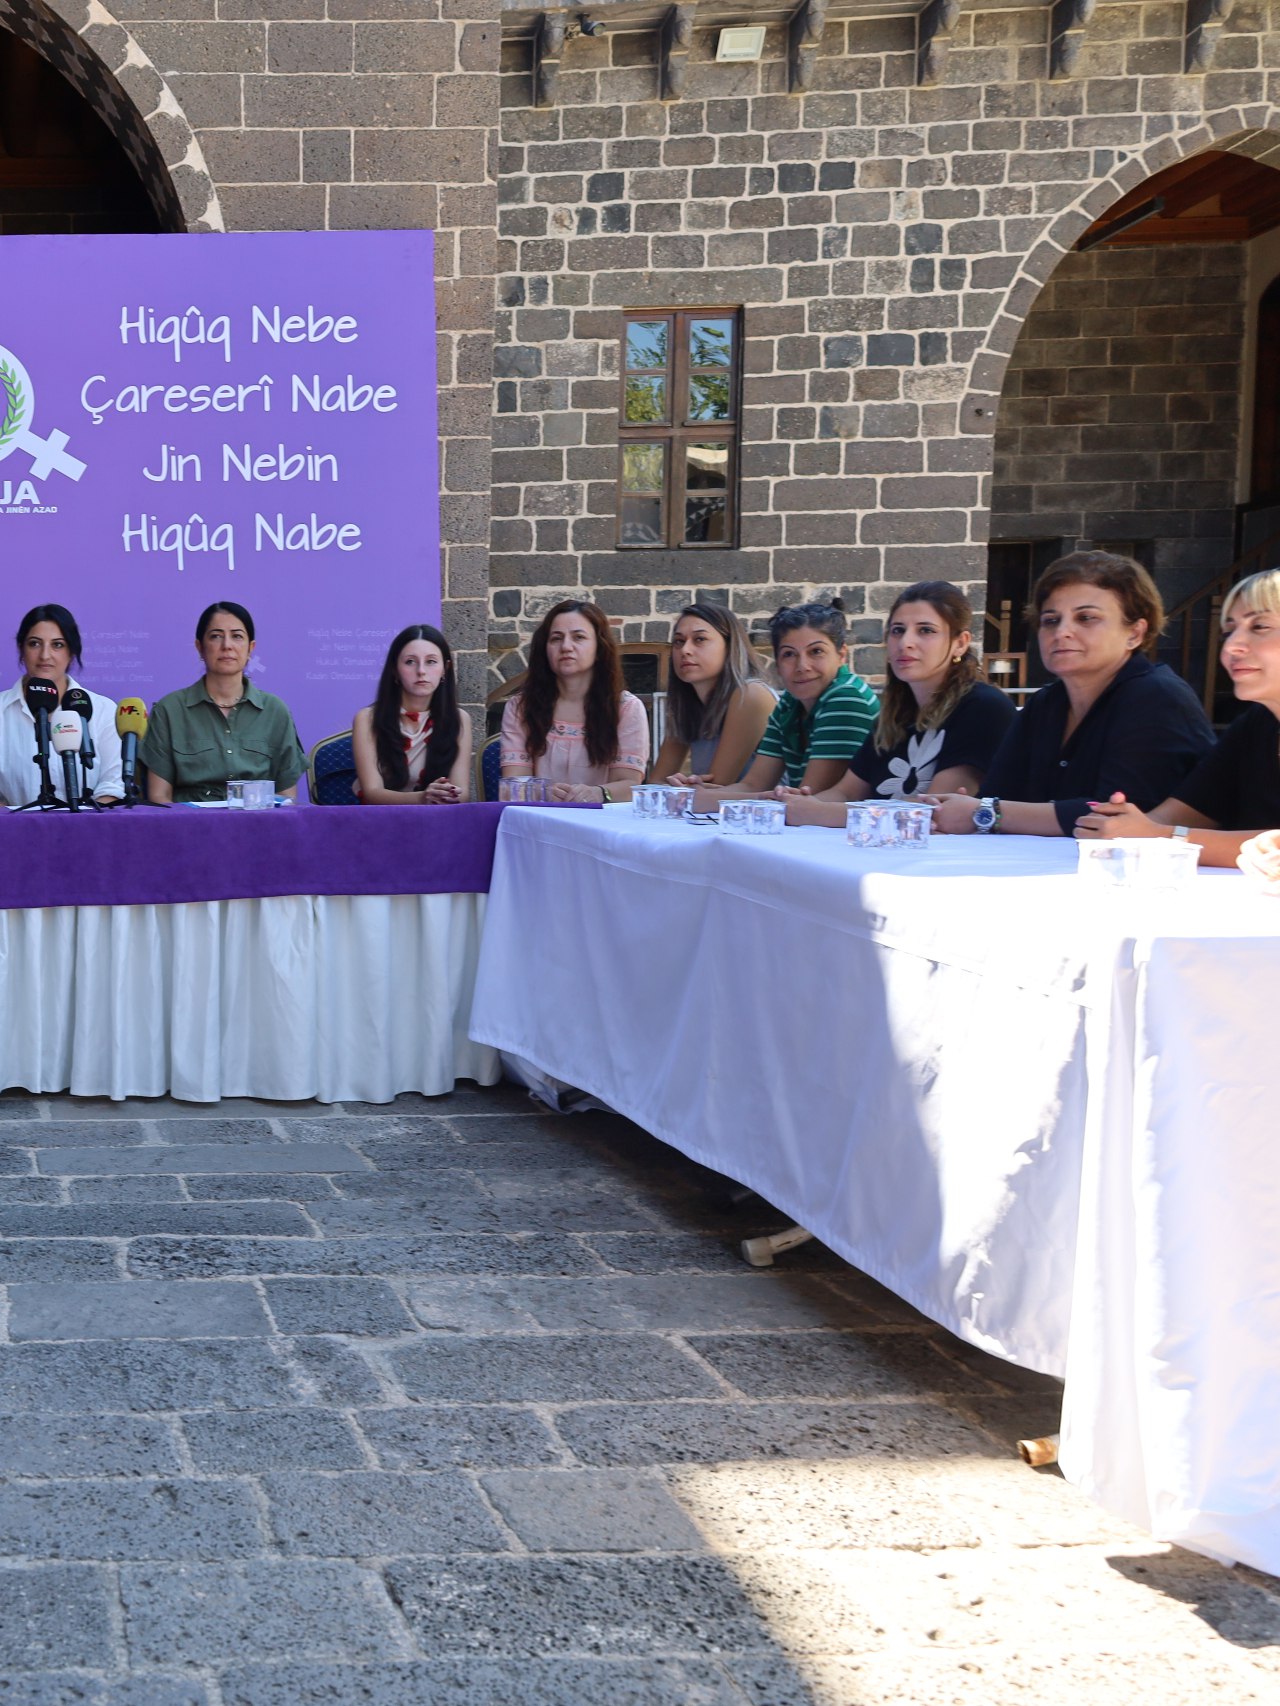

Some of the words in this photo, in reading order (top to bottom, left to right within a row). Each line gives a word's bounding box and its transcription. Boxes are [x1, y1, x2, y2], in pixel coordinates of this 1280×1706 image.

[119, 306, 231, 362] Hiqûq
[252, 305, 358, 343] Nebe
[81, 375, 273, 424] Çareserî
[292, 375, 398, 412] Nabe
[143, 445, 201, 481] Jin
[223, 444, 338, 481] Nebin
[122, 514, 234, 570] Hiqûq
[255, 513, 362, 551] Nabe
